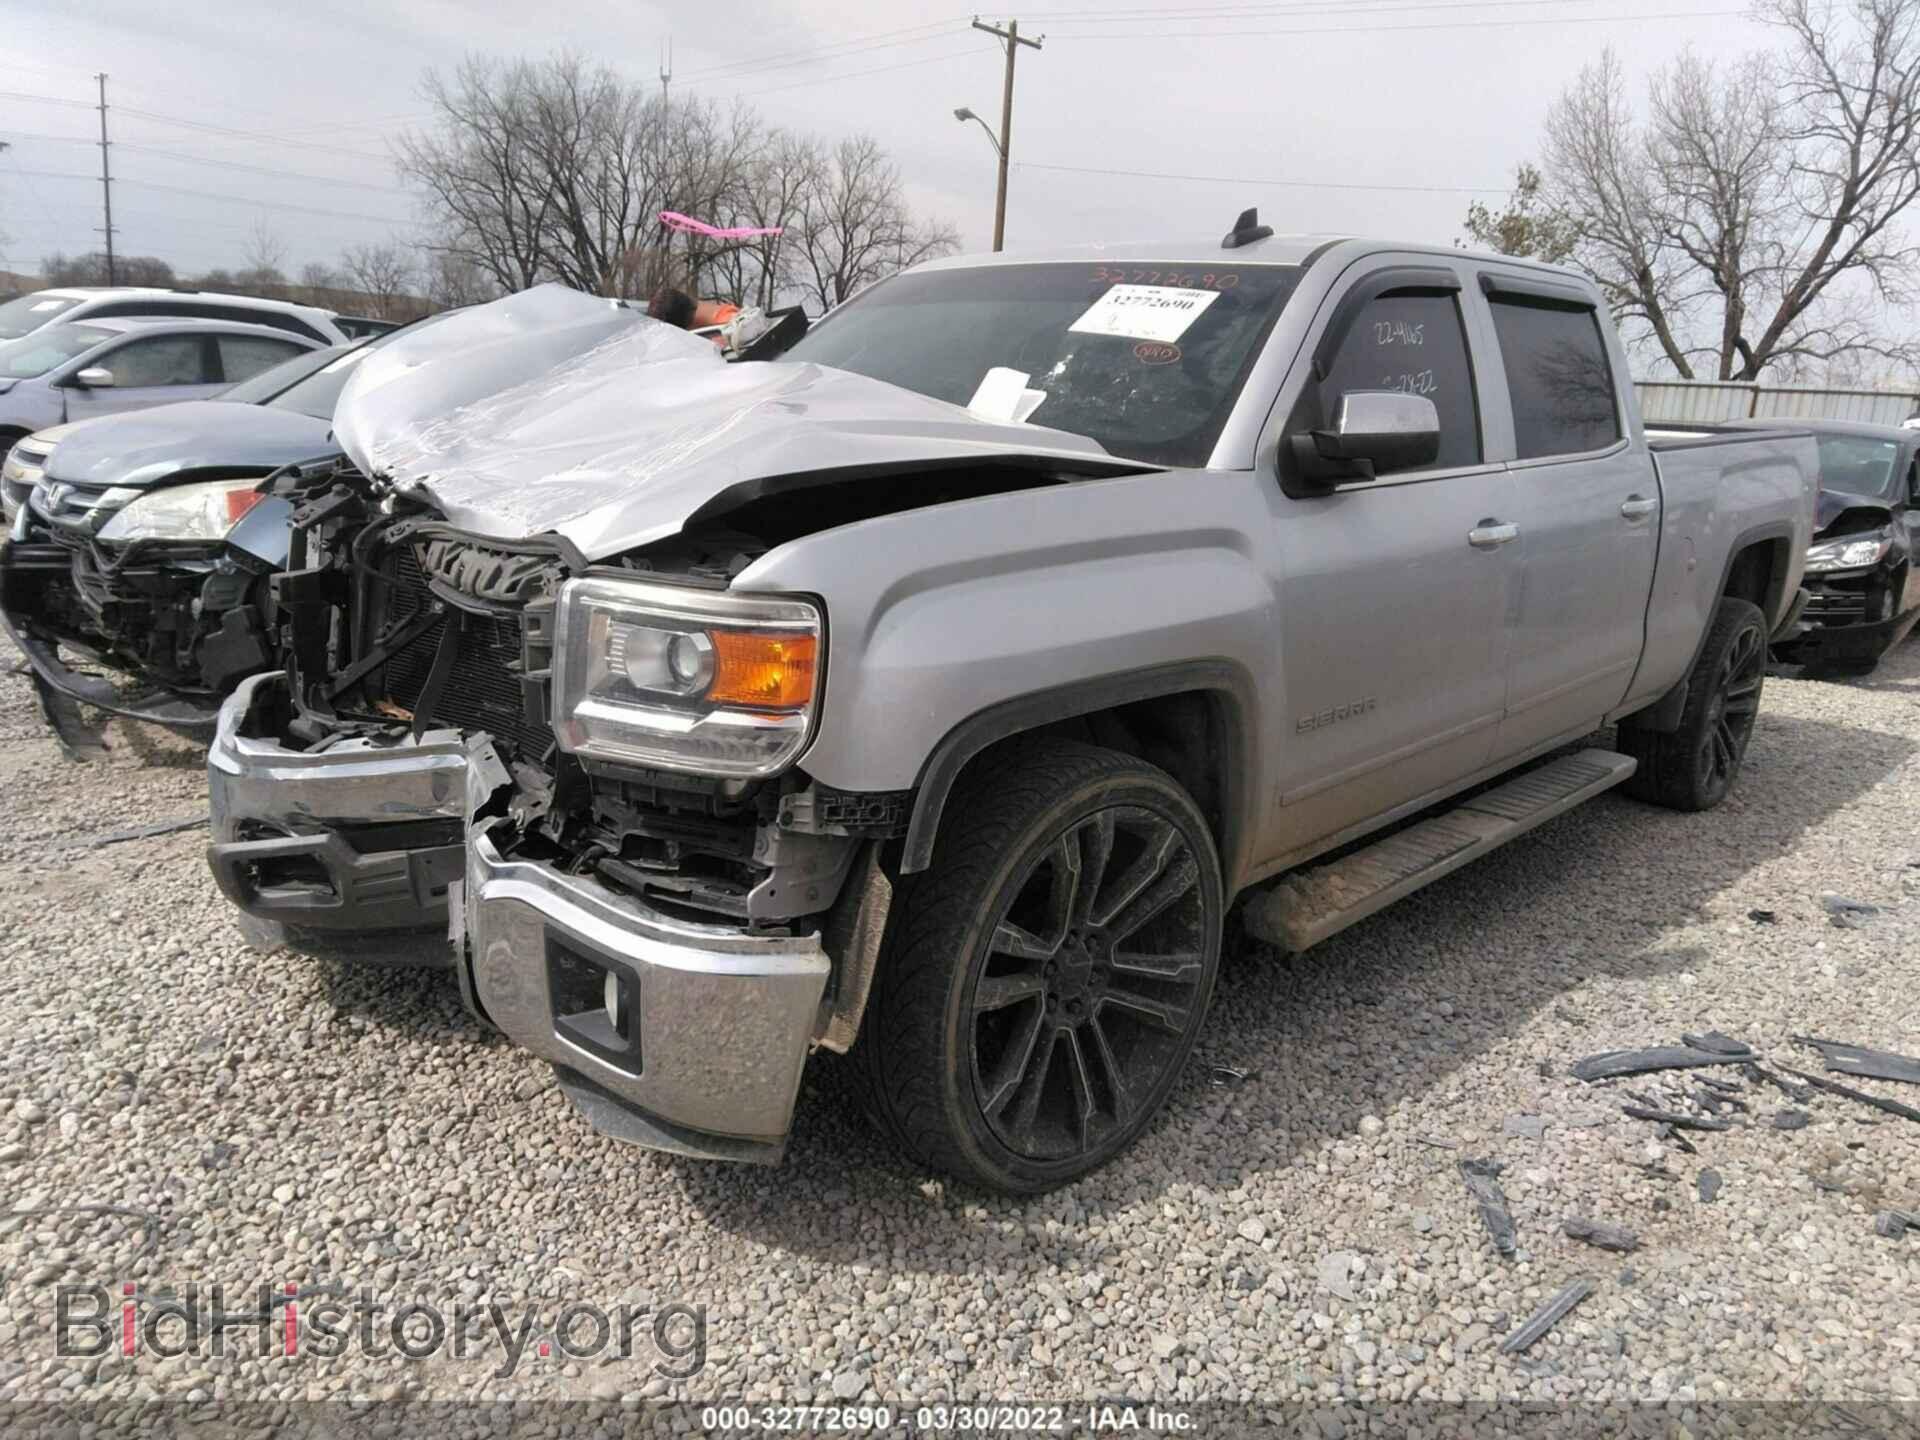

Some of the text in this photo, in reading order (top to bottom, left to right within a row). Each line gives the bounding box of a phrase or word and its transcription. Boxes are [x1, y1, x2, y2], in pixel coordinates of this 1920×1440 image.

[1089, 266, 1240, 290] 32772690
[1107, 295, 1196, 311] 32772690
[1296, 697, 1378, 733] SIERRA
